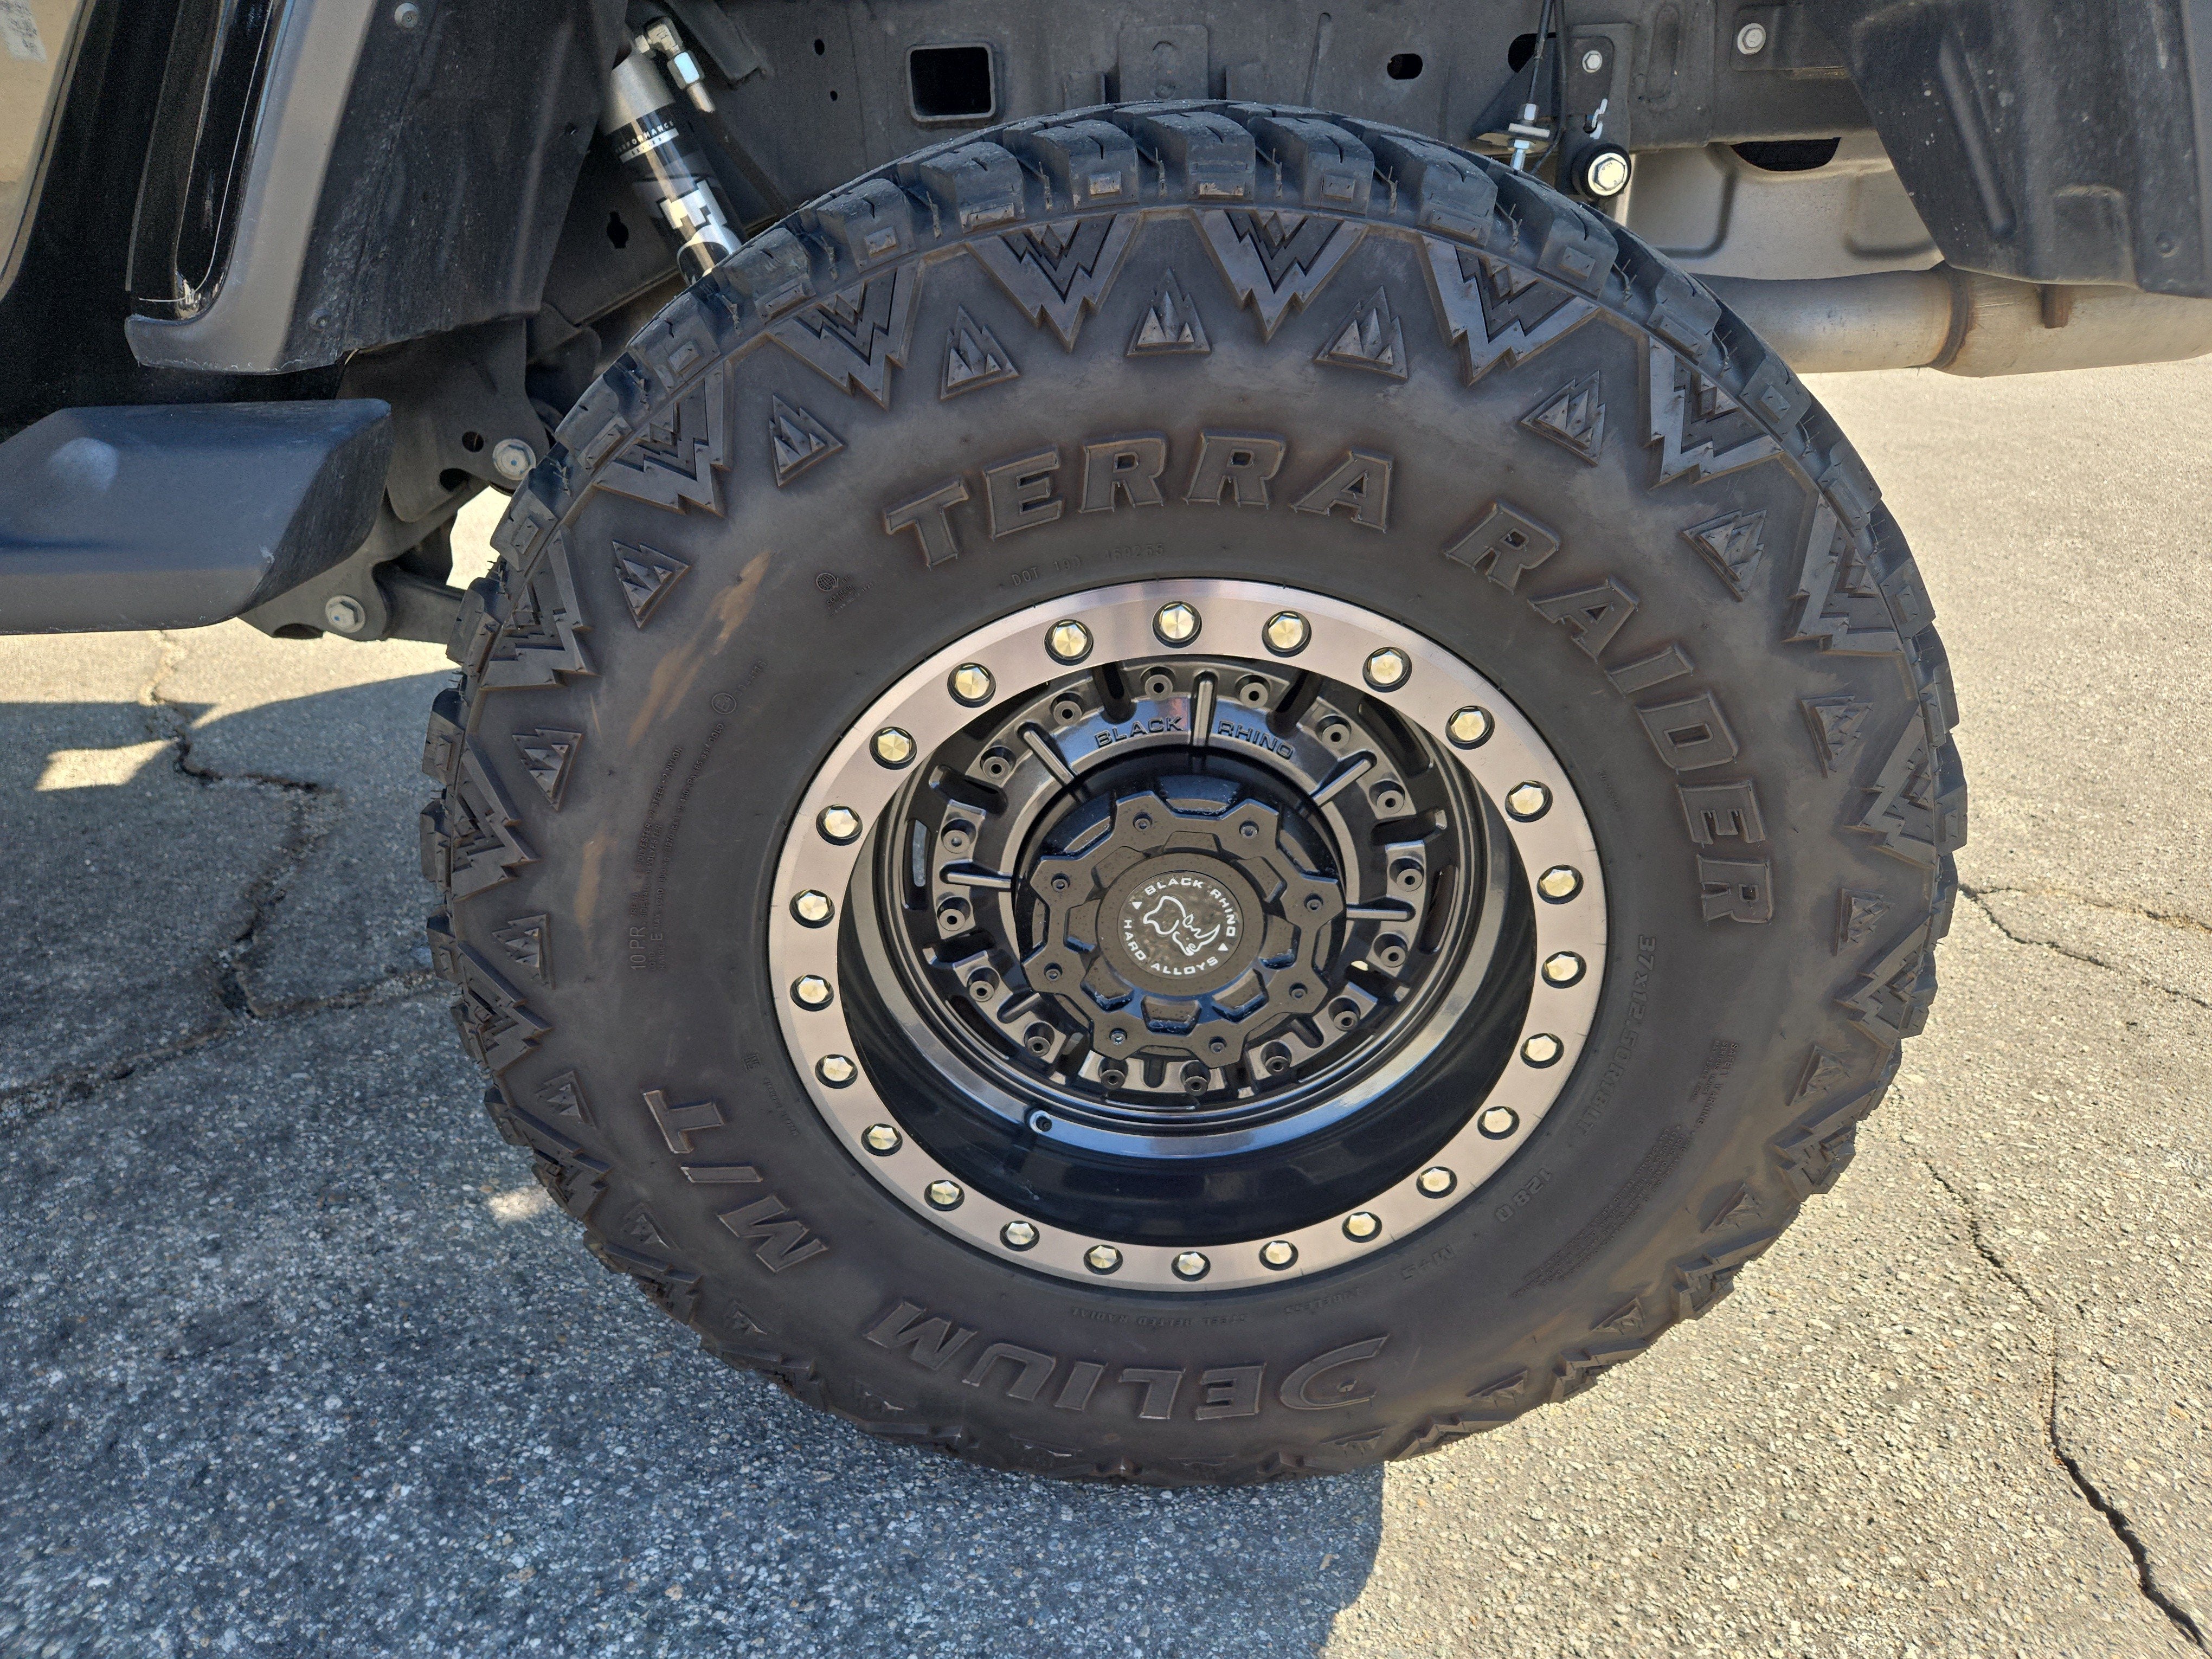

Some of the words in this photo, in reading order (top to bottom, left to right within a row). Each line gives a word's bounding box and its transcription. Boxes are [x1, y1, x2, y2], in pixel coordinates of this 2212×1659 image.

[1010, 567, 1040, 586] DOT
[885, 429, 1393, 569] TERRA
[1444, 499, 1773, 925] RAIDER
[707, 722, 725, 743] COLD
[1095, 716, 1182, 749] BLACK
[1217, 721, 1294, 758] RHINO
[665, 745, 683, 771] NYLON
[1144, 877, 1204, 896] BLACK
[1210, 888, 1236, 937] RHINO
[629, 954, 646, 970] 10
[1123, 919, 1147, 961] HARD
[1150, 956, 1218, 975] ALLOYS
[1719, 1042, 1739, 1078] SAFETY
[642, 1089, 828, 1274] M/T
[1508, 1166, 1555, 1209] 128
[1398, 1243, 1458, 1283] M+S
[1068, 1306, 1130, 1324] RADIAL
[862, 1301, 1390, 1421] DELIUM
